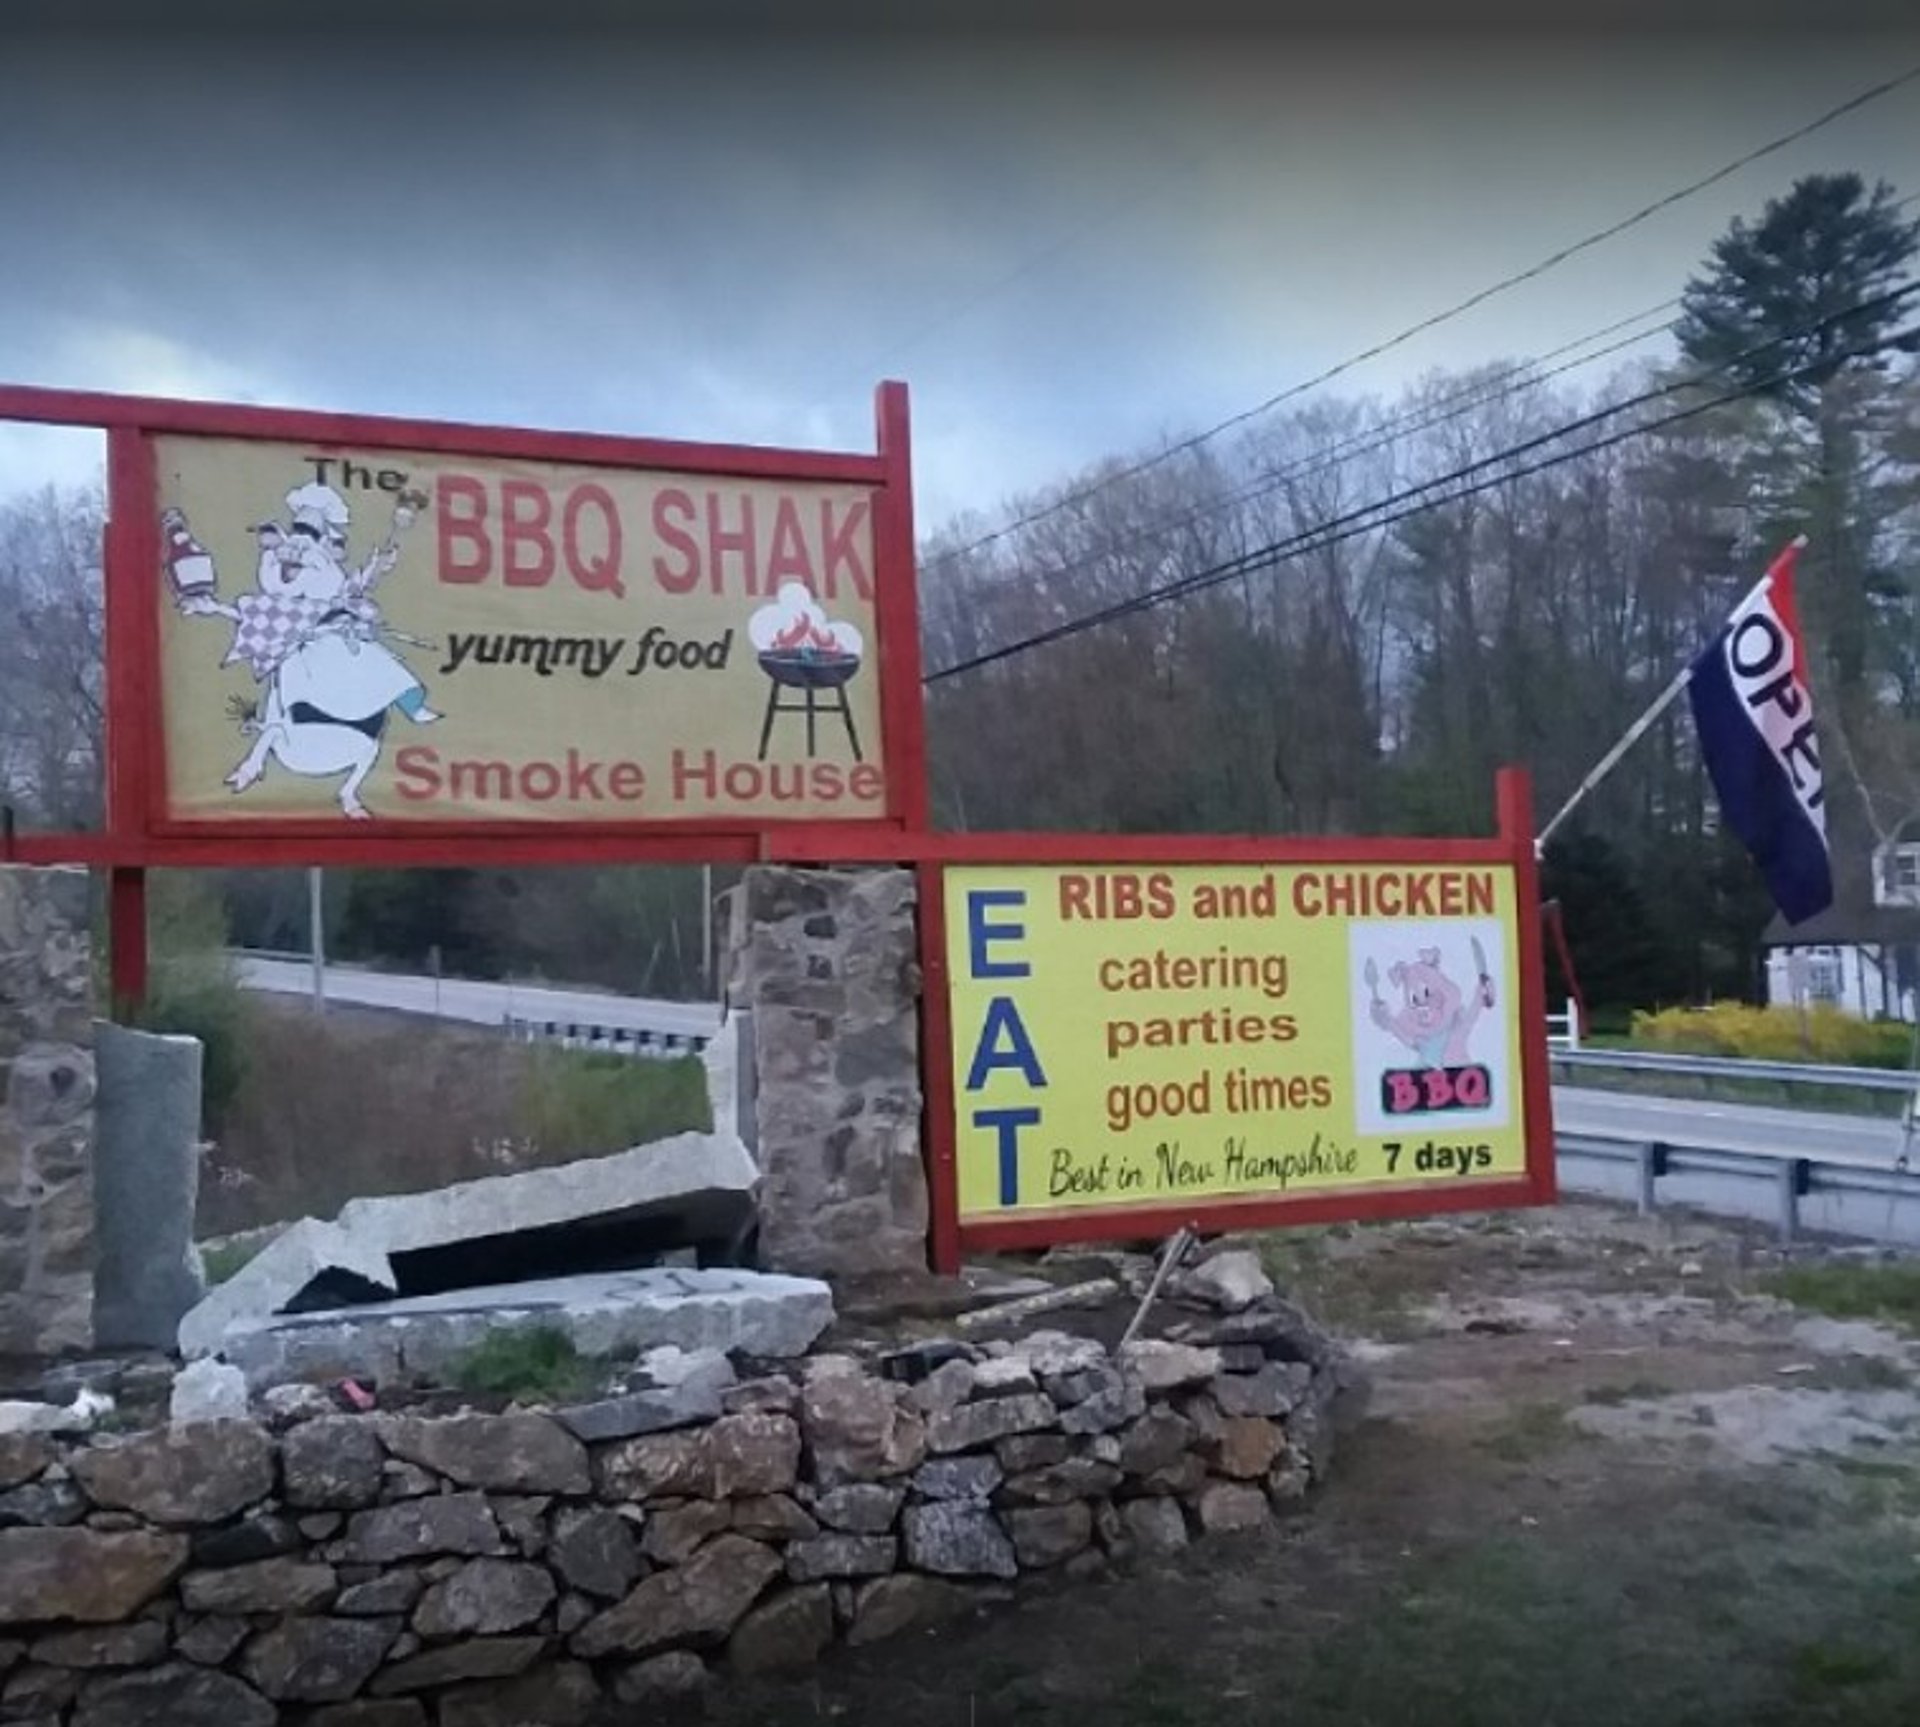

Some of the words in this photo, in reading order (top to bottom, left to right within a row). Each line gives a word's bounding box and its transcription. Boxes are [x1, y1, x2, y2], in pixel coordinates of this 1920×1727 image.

[305, 457, 408, 491] The
[436, 475, 625, 598] BBQ
[651, 489, 875, 600] SHAK
[440, 632, 624, 677] yummy
[628, 627, 734, 676] food
[394, 746, 645, 801] Smoke
[671, 749, 886, 800] House
[1059, 875, 1175, 919] RIBS
[1193, 875, 1276, 918] and
[1292, 872, 1494, 917] CHICKEN
[1100, 946, 1288, 997] catering
[965, 890, 1048, 1206] EAT
[1107, 1008, 1297, 1057] parties
[1107, 1071, 1211, 1131] good
[1225, 1071, 1332, 1111] times
[1387, 1067, 1492, 1112] BBQ
[1050, 1148, 1110, 1196] Best
[1116, 1157, 1142, 1189] in
[1156, 1142, 1213, 1189] New
[1223, 1132, 1357, 1190] Hampshire
[1382, 1143, 1401, 1172] 7
[1415, 1142, 1492, 1174] days
